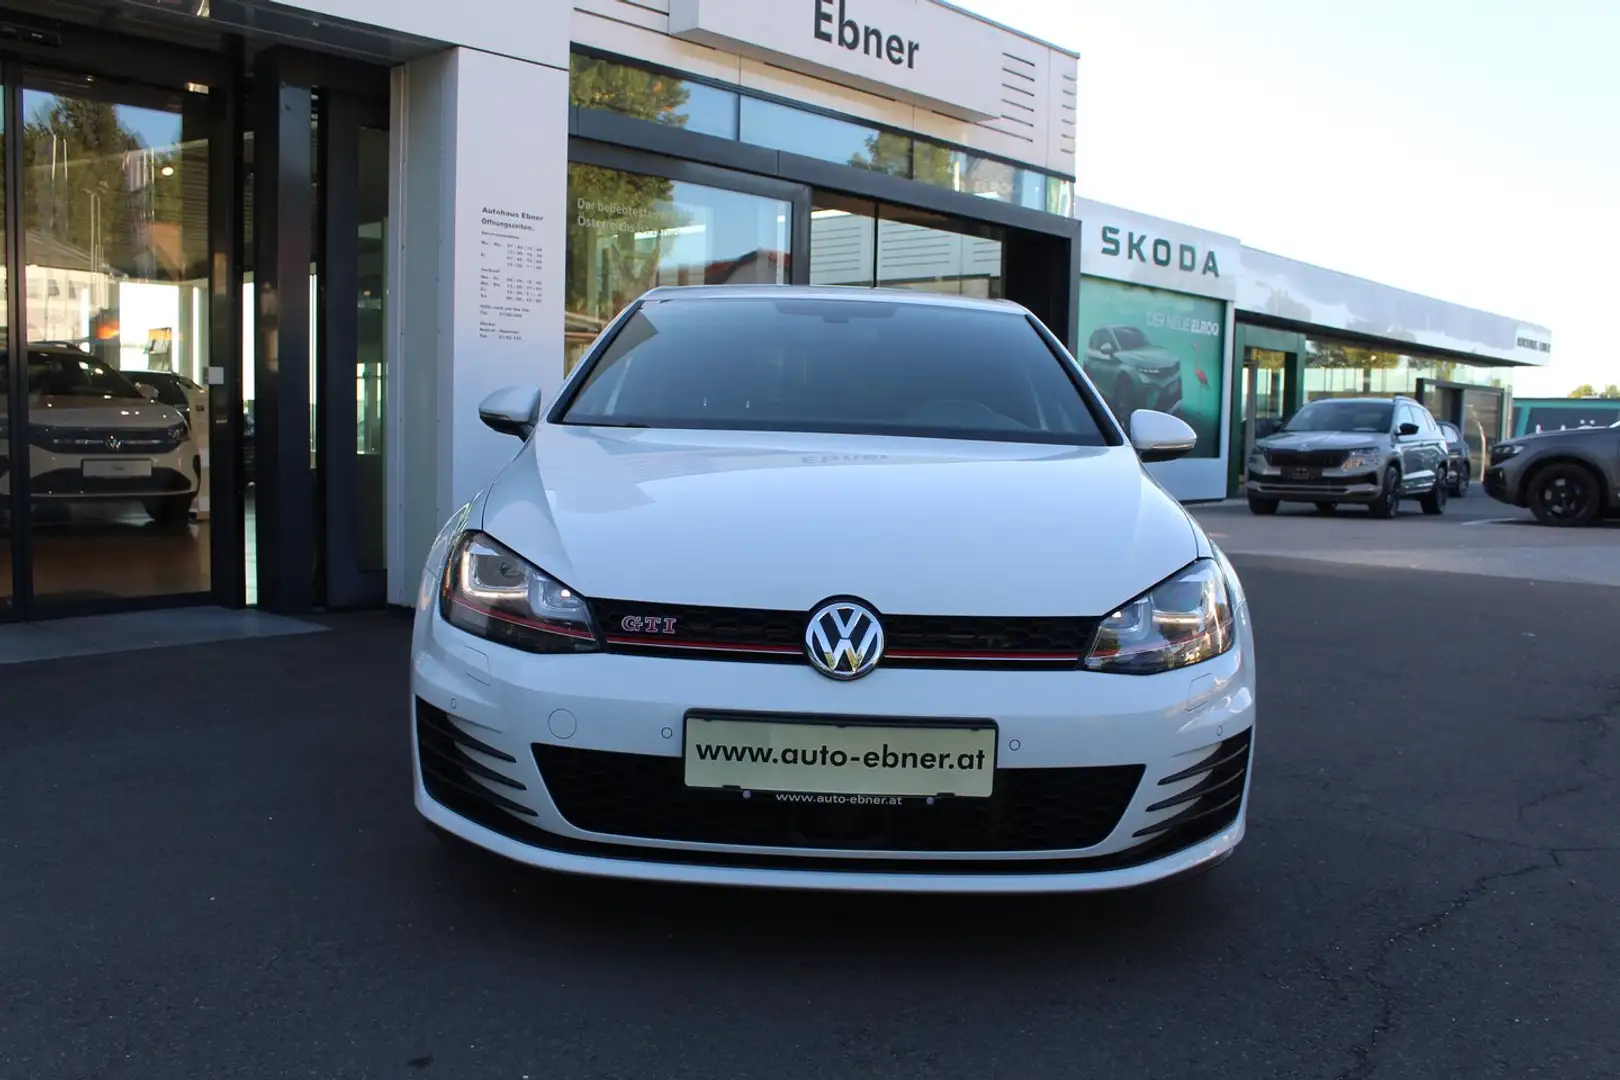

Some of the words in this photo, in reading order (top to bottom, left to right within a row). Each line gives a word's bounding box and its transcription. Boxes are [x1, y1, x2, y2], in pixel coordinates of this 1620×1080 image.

[814, 0, 920, 69] Ebner
[577, 197, 595, 211] Der
[481, 206, 520, 219] Autohaus
[521, 212, 545, 221] Ebner
[621, 615, 677, 634] GTI
[695, 743, 986, 770] www.auto-ebner.at
[775, 792, 903, 806] www.auto-ebner.at
